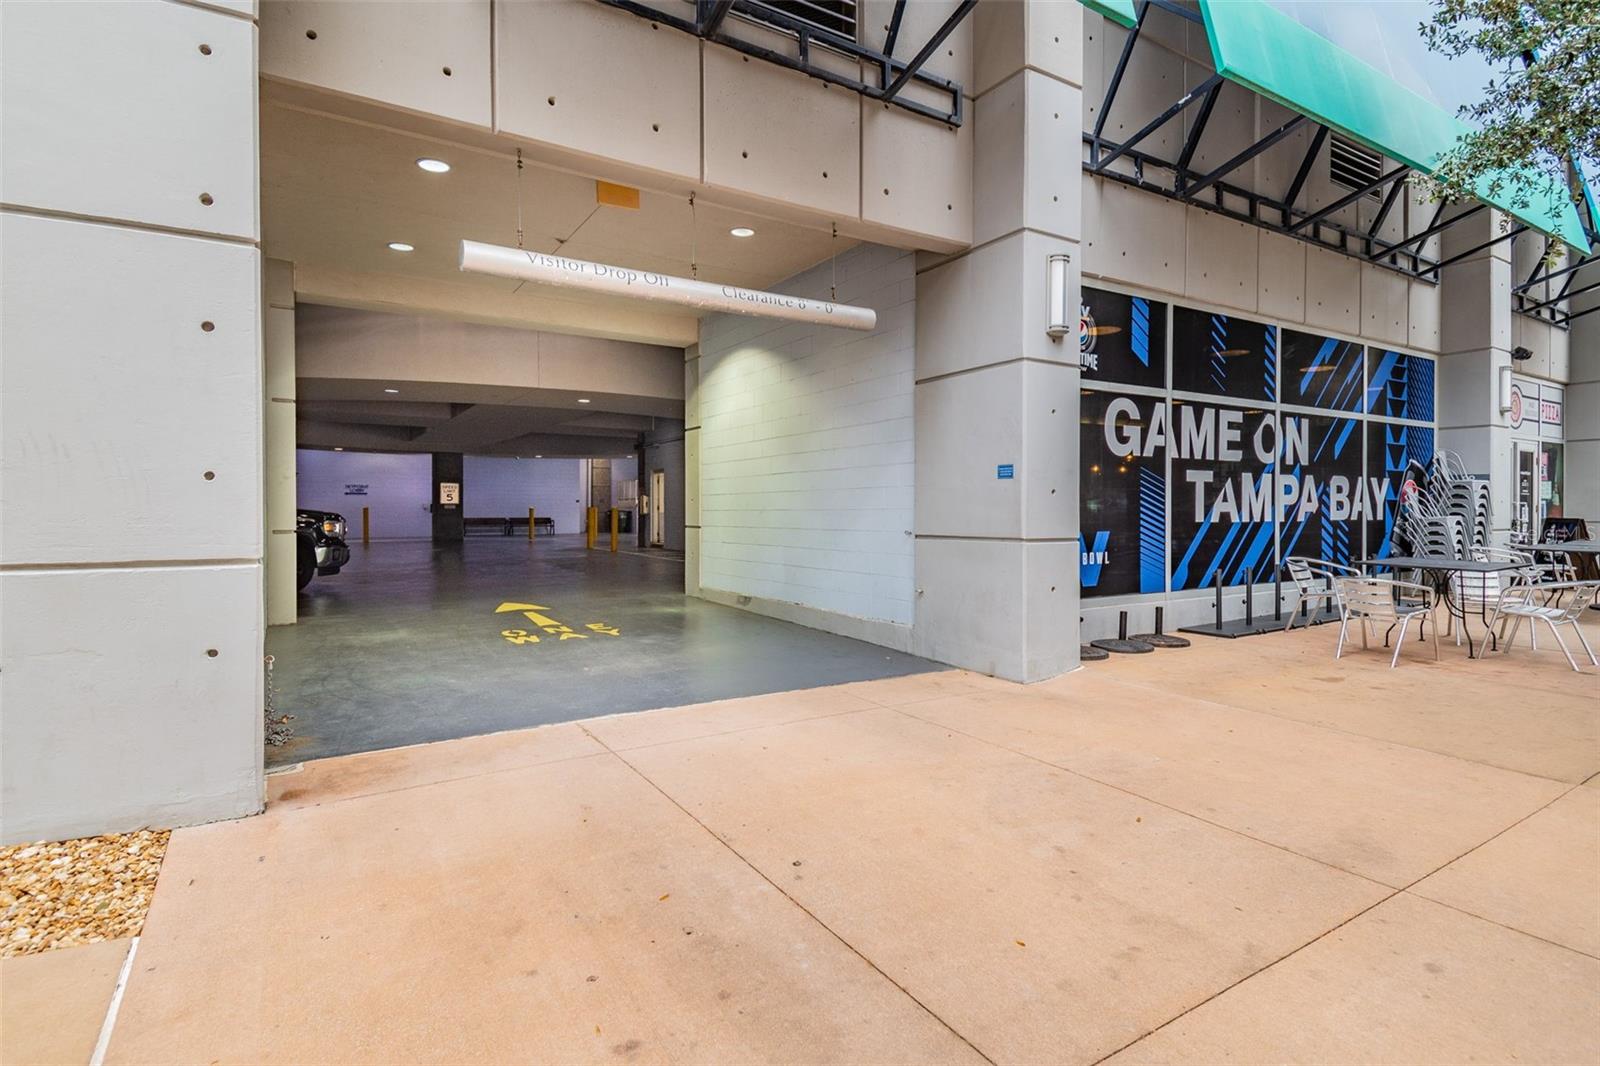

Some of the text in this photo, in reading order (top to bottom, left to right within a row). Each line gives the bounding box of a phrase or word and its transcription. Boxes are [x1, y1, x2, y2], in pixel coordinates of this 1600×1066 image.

[526, 252, 586, 273] Visitor
[594, 263, 637, 285] Drop
[721, 286, 794, 308] Clearance
[1104, 397, 1310, 466] GAME ON
[446, 494, 454, 502] 5
[1186, 470, 1390, 523] TAMPA BAY
[1082, 552, 1110, 565] BOWL
